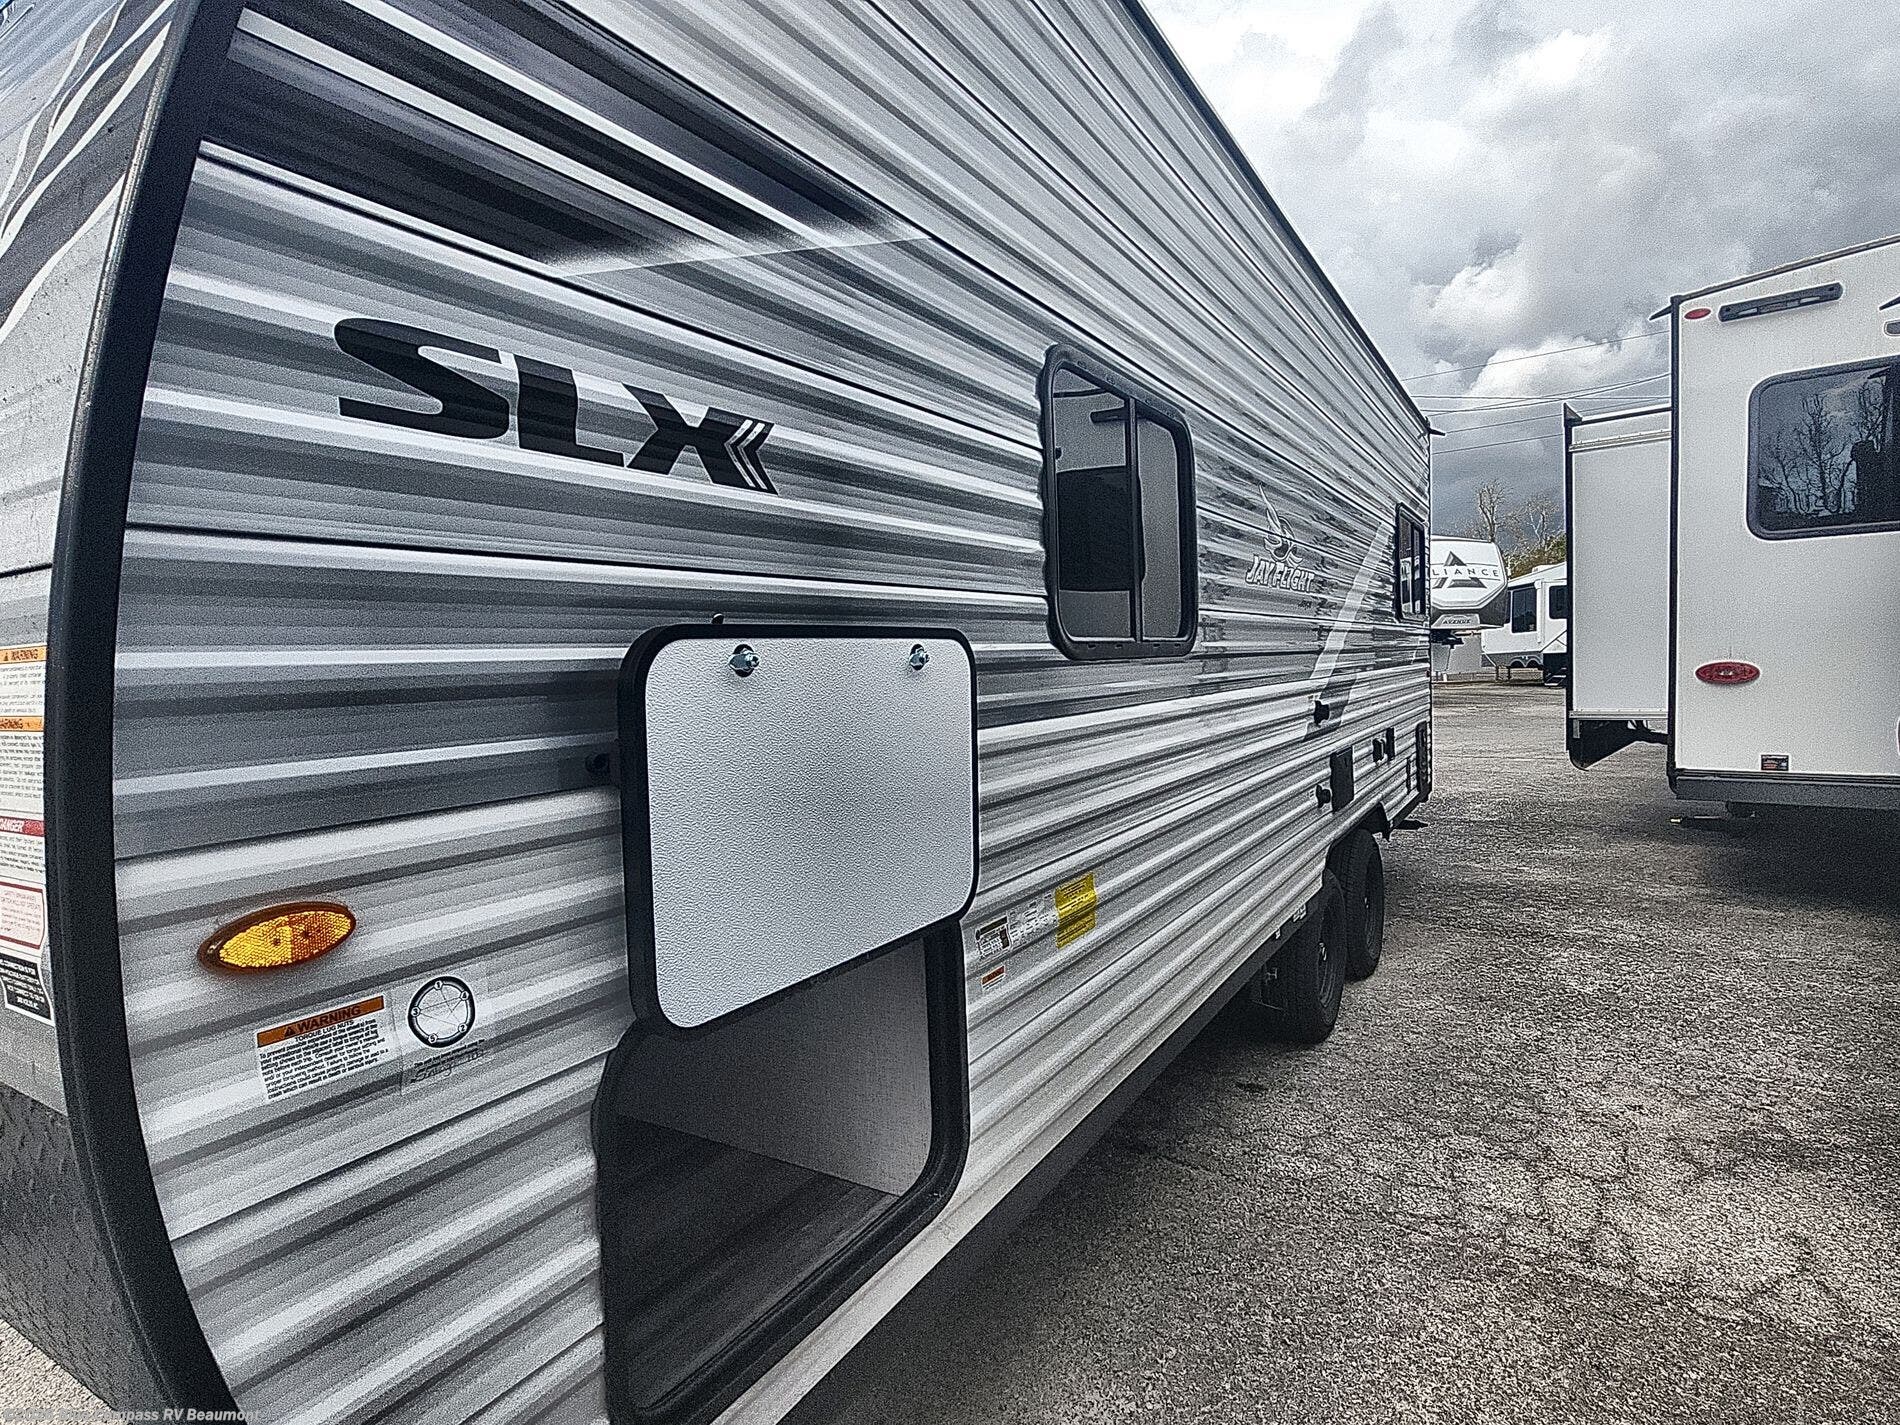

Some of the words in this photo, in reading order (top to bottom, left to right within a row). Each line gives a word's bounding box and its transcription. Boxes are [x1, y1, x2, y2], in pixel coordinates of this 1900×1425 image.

[334, 317, 779, 495] SLX
[1246, 555, 1275, 585] JAY
[1271, 561, 1316, 592] FLIGHT
[1432, 568, 1499, 577] LIANCE
[295, 1029, 321, 1042] TORQUE
[322, 1025, 337, 1034] LUG
[337, 1020, 355, 1030] NUTS
[298, 1005, 360, 1032] WARNING
